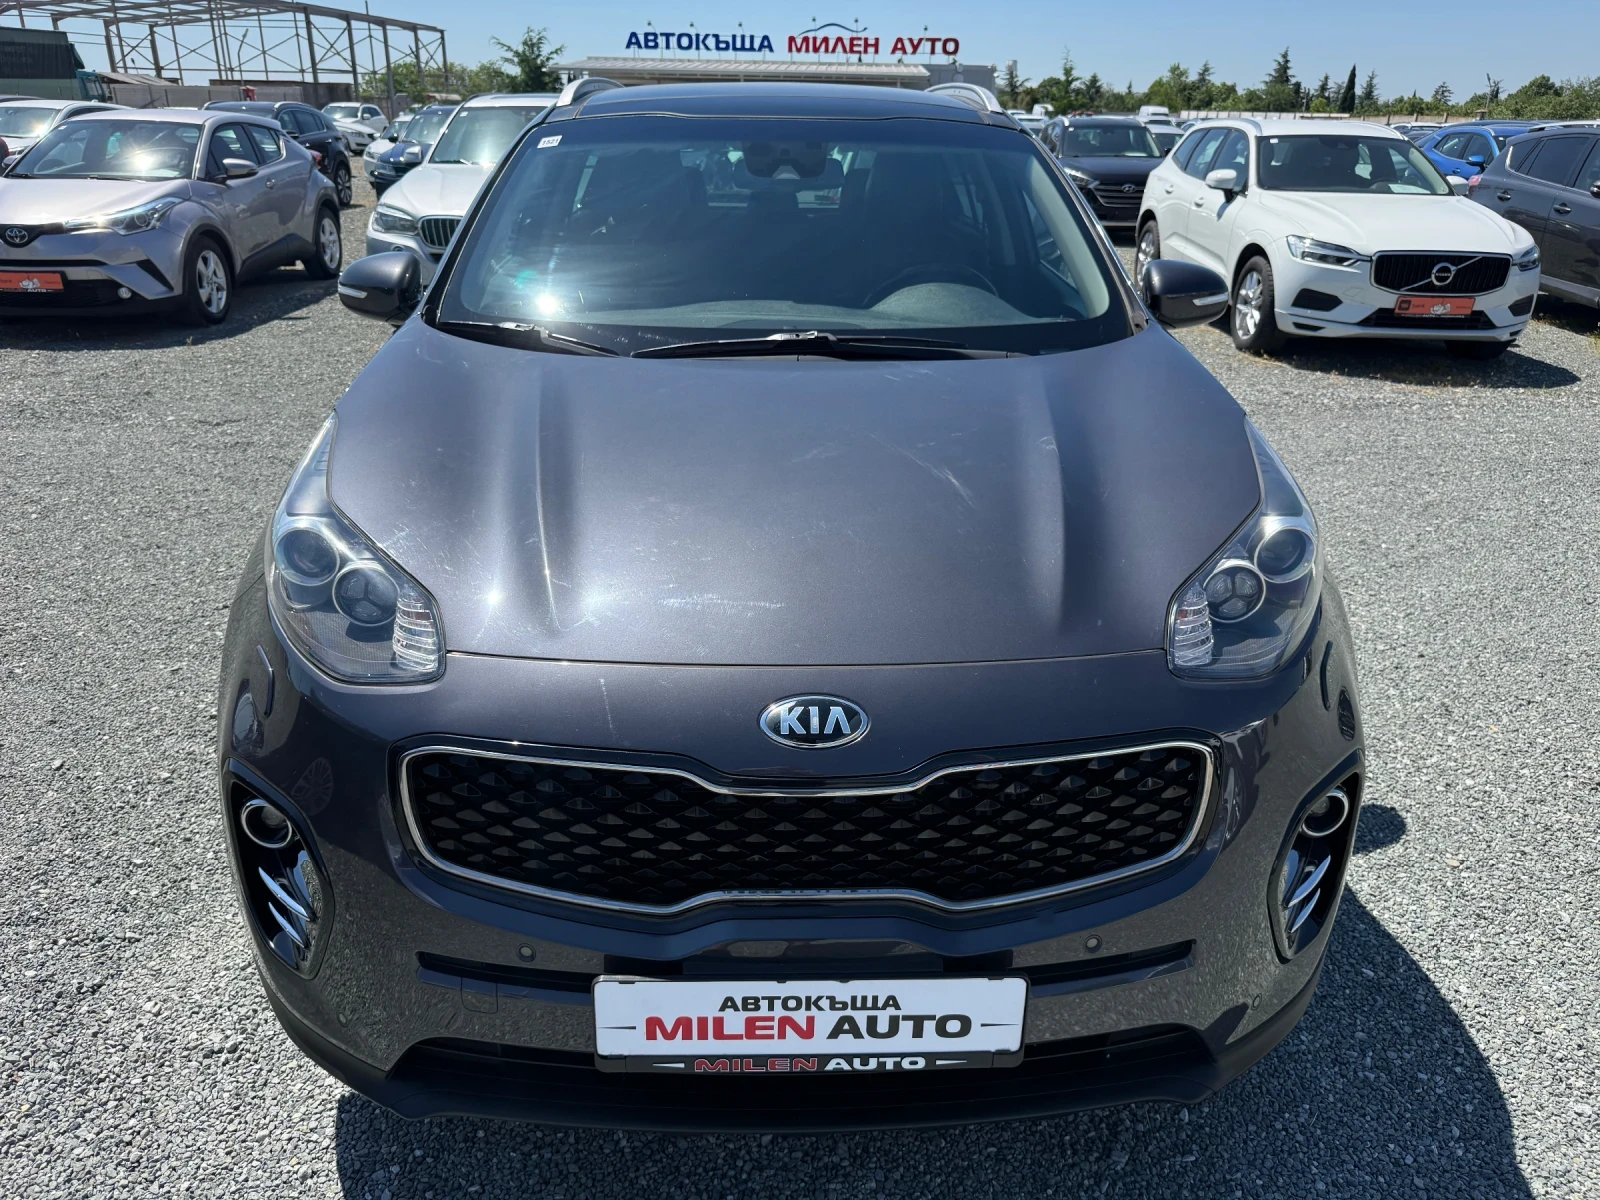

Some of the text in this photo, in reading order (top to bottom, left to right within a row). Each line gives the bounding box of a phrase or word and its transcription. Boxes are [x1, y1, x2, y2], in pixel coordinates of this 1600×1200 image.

[787, 35, 880, 56] МИЛЕН
[890, 37, 960, 56] АУТО
[542, 138, 559, 146] 1521
[780, 706, 852, 735] KIA
[645, 1014, 972, 1041] MILEN AUTO
[694, 1056, 926, 1072] MILEN AUTO
